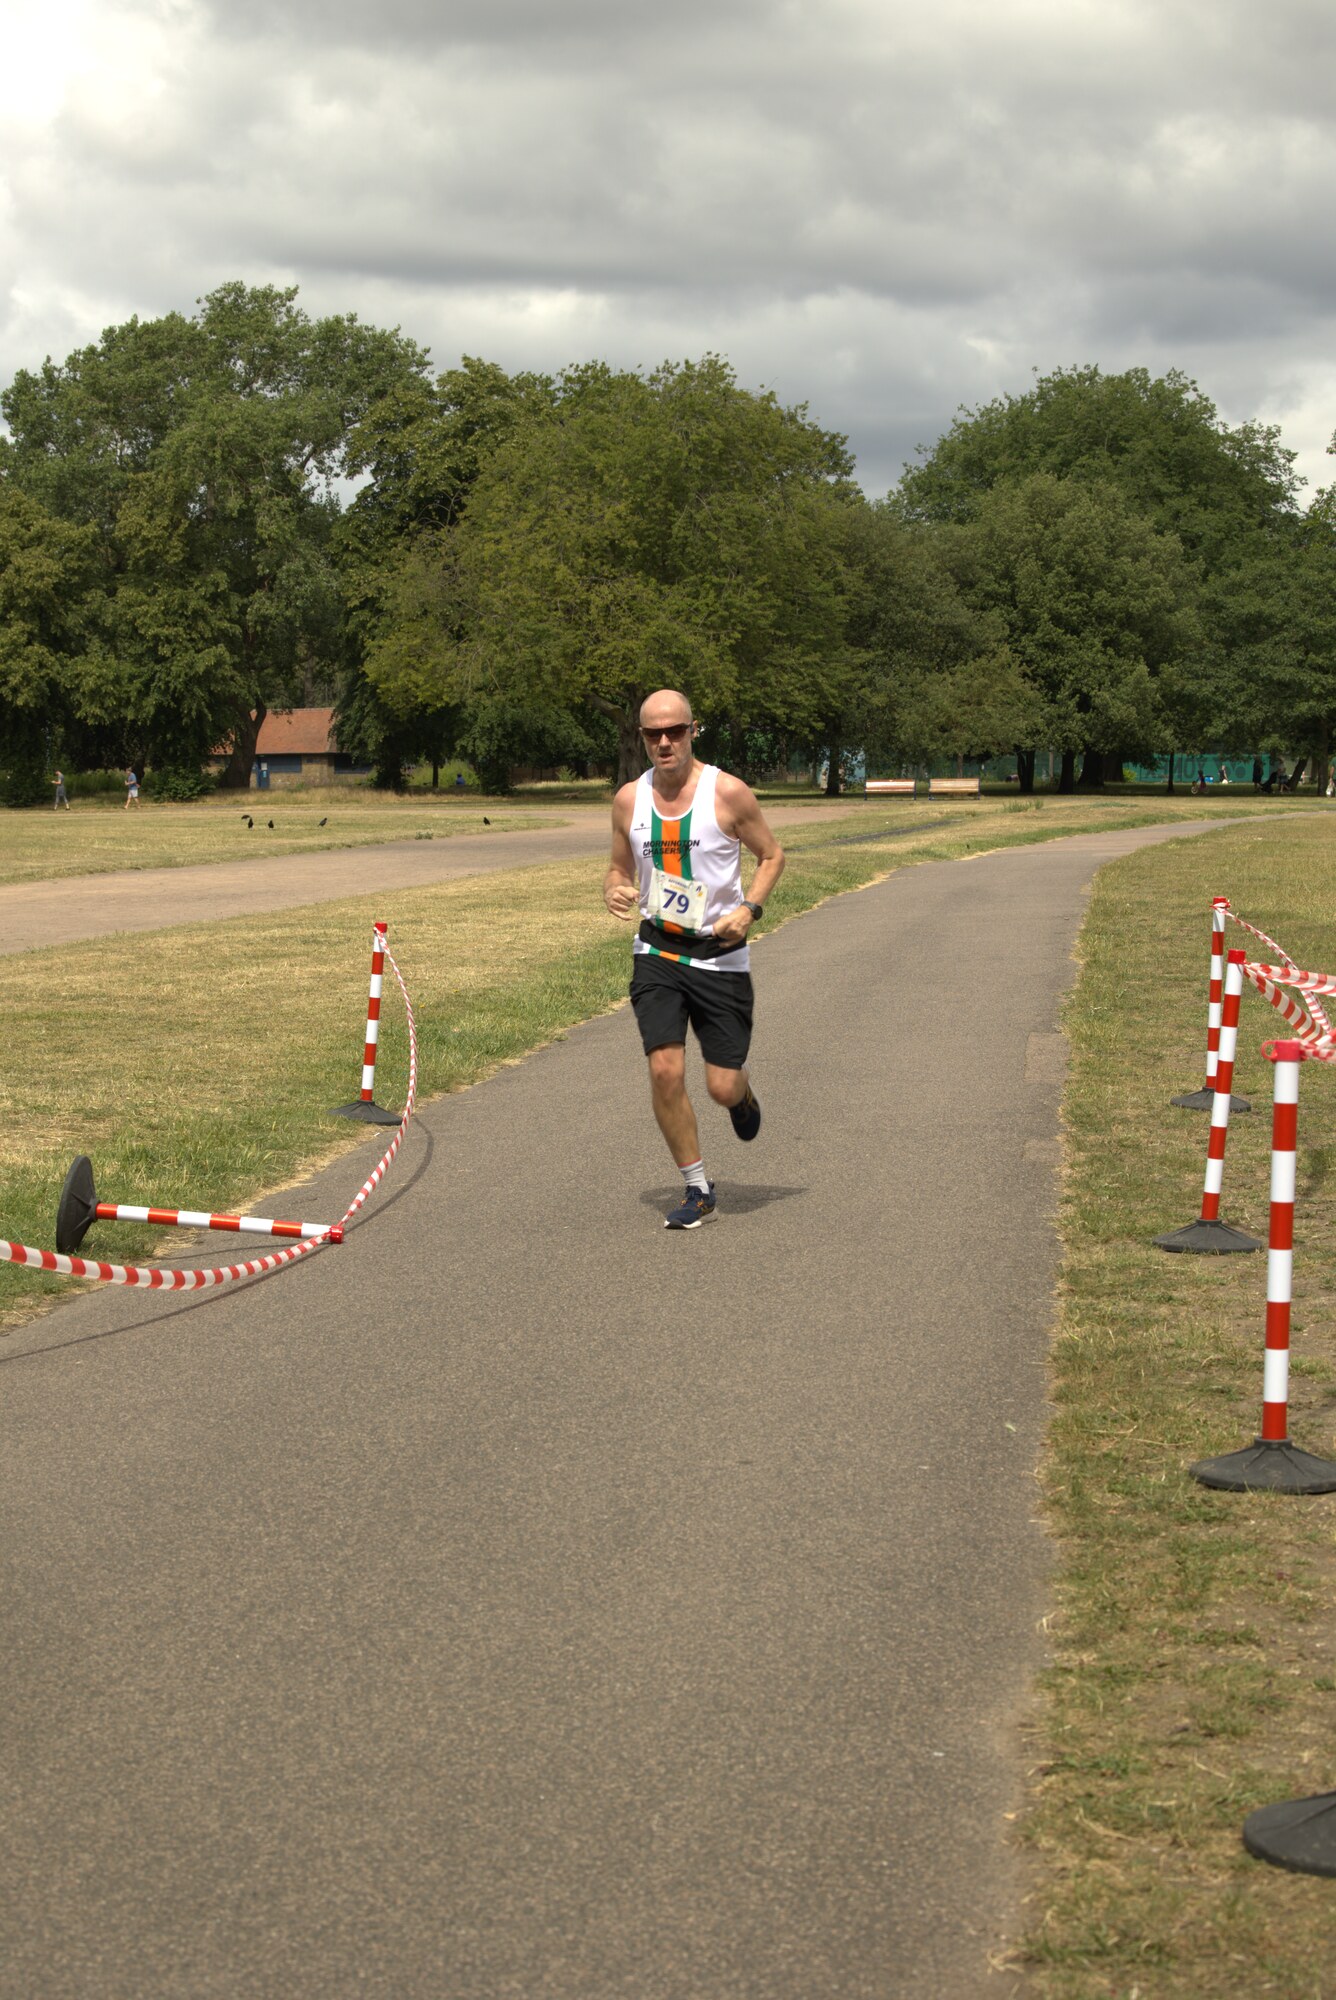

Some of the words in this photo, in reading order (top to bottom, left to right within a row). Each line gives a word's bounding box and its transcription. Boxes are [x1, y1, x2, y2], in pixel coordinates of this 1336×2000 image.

[643, 840, 700, 848] MORNINGTON
[643, 847, 681, 856] CHASERS
[662, 888, 689, 914] 79
